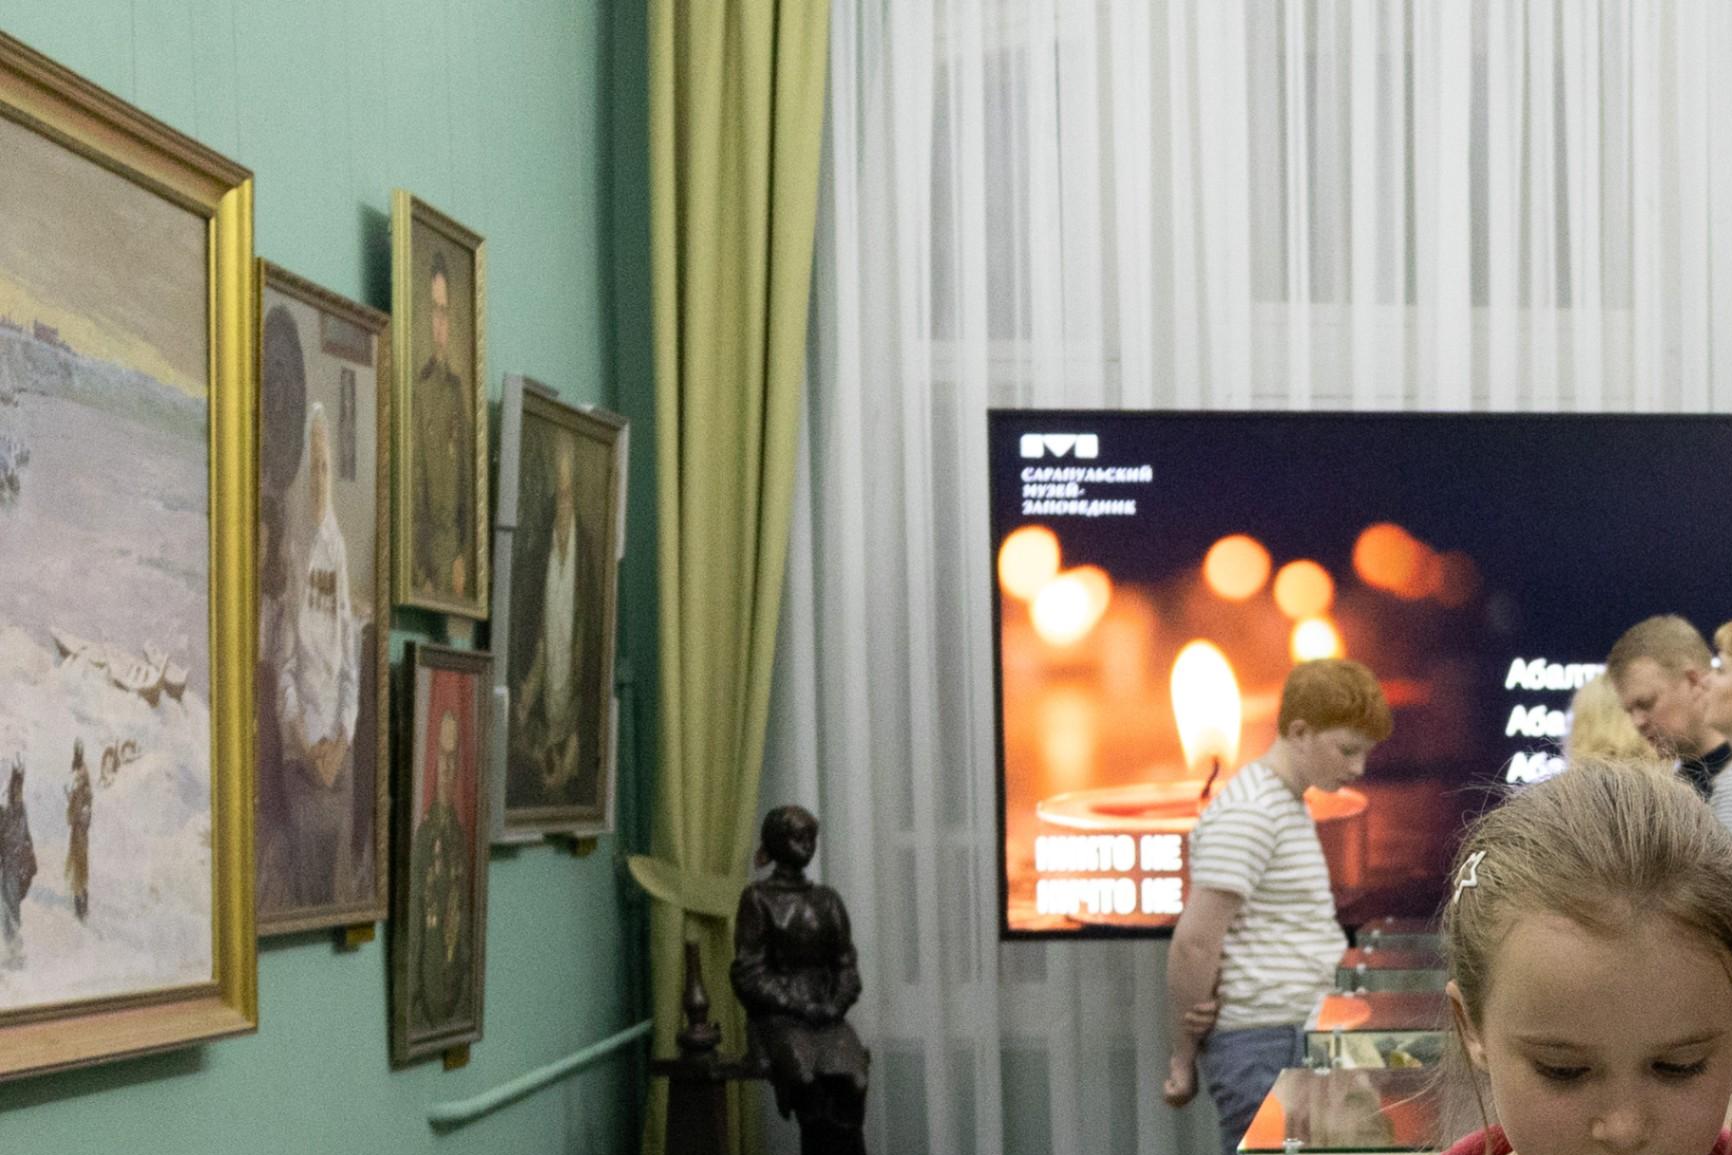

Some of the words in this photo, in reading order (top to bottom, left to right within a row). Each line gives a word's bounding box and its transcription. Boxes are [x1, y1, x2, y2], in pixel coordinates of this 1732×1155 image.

[1021, 465, 1153, 483] САРАПУЛЬСКИЙ
[1022, 482, 1085, 498] МУЗЕЙ-
[1022, 499, 1136, 517] ЗАПОВЕДНИК
